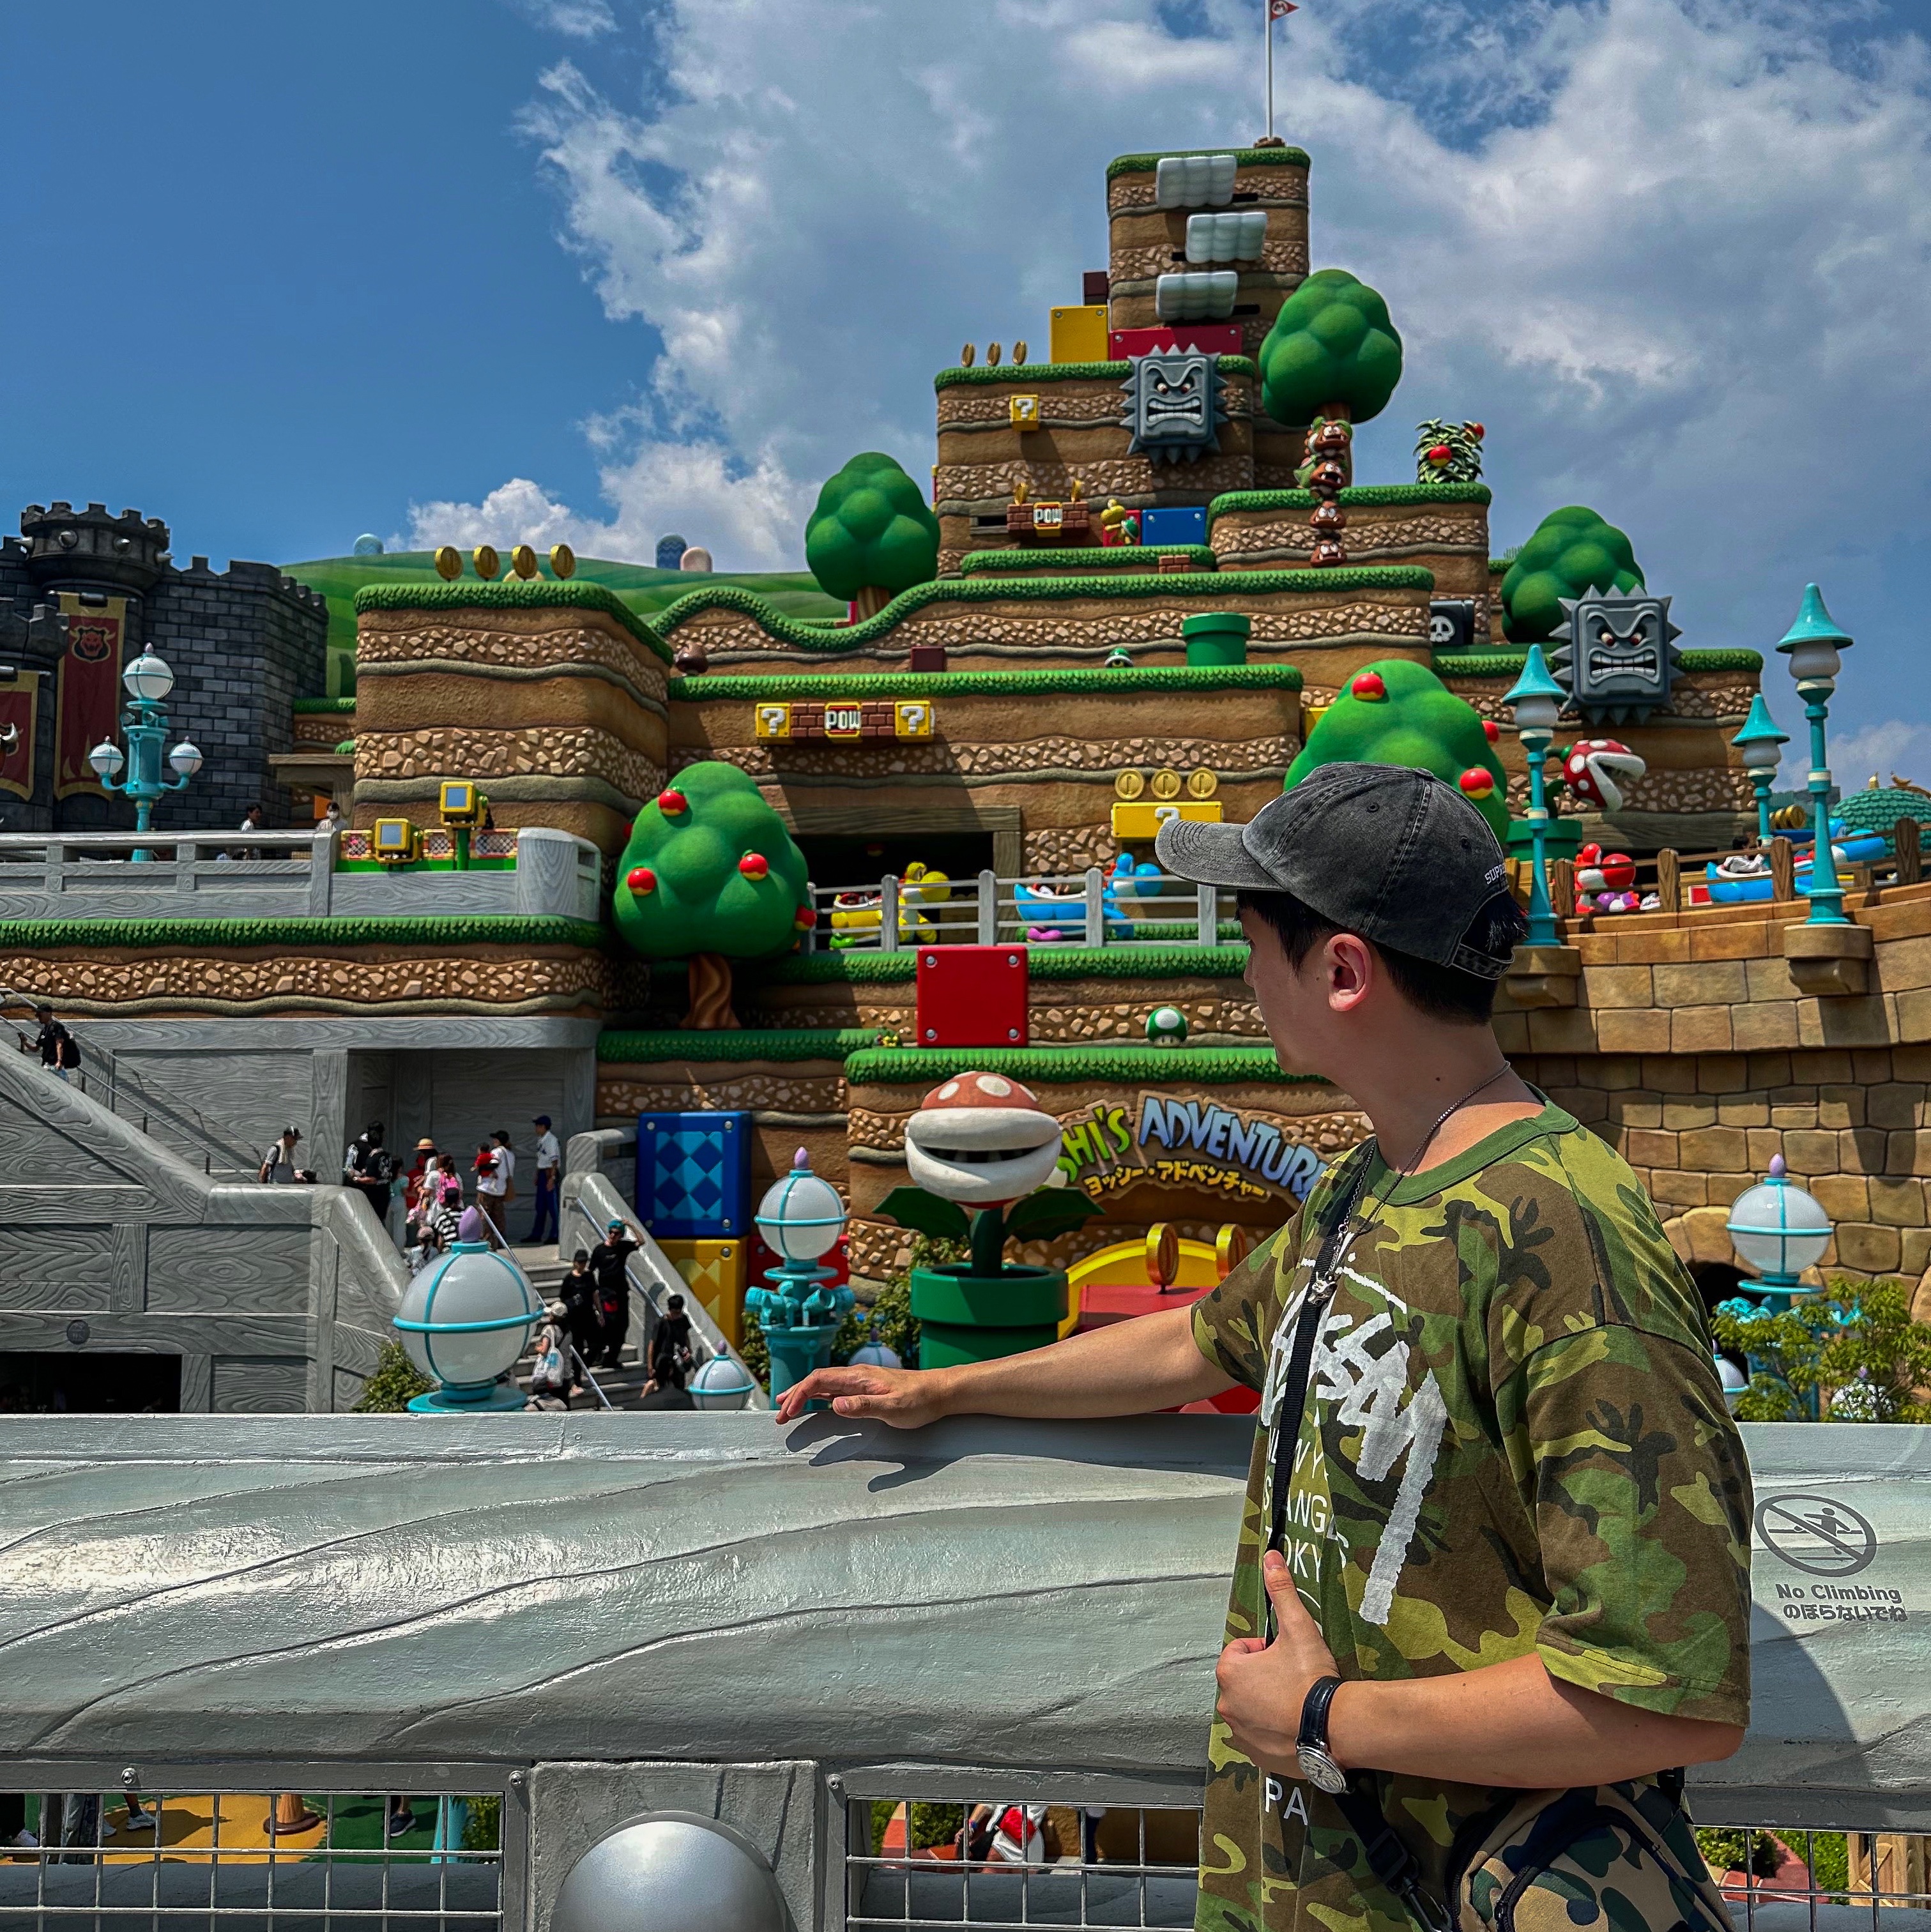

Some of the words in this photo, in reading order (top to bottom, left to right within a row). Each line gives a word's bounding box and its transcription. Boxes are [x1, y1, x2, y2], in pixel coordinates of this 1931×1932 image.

[1034, 508, 1063, 524] POW
[761, 708, 786, 734] ?
[825, 710, 861, 730] POW
[900, 705, 925, 732] ?
[1084, 1159, 1266, 1197] ヨッシー・アドベンチャー
[1776, 1584, 1805, 1599] No
[1811, 1585, 1902, 1603] Climbing
[1783, 1604, 1909, 1622] のぼらないでね
